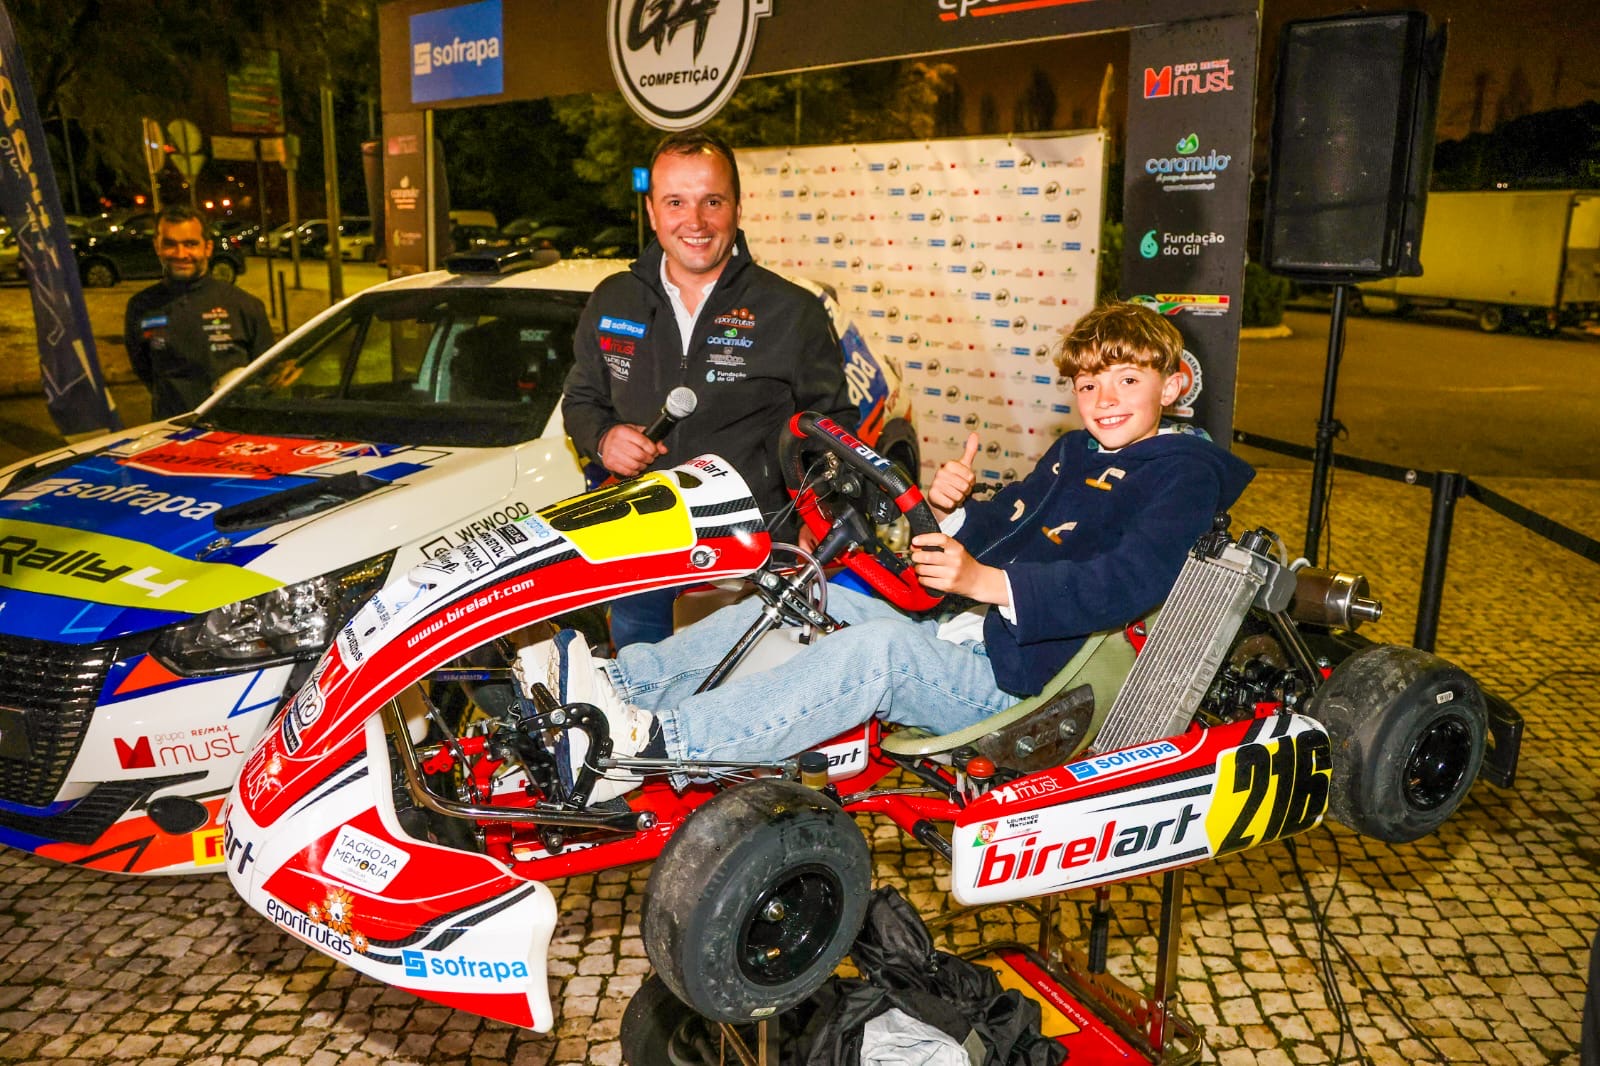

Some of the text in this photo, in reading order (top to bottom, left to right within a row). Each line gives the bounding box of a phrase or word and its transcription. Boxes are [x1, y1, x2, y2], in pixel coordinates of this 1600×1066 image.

[433, 36, 499, 67] sofrapa
[639, 66, 719, 87] COMPETIÇÃO
[1173, 66, 1234, 96] must
[1145, 150, 1230, 174] caramulo
[1163, 231, 1225, 246] Fundação
[1163, 245, 1200, 256] do Gil
[611, 322, 644, 335] sofrapa
[53, 482, 223, 520] sofrapa
[455, 502, 529, 542] WEWOOD
[0, 535, 189, 598] Rally 4
[407, 577, 535, 649] www.birelart.com
[191, 725, 228, 736] RE/MAX
[160, 732, 244, 766] must
[1096, 742, 1177, 769] sofrapa
[1017, 777, 1063, 798] must
[1218, 729, 1333, 856] 216
[341, 834, 397, 869] TACHO DA
[974, 804, 1202, 888] birelart
[266, 898, 352, 956] eporifrutas
[431, 955, 529, 982] sofrapa
